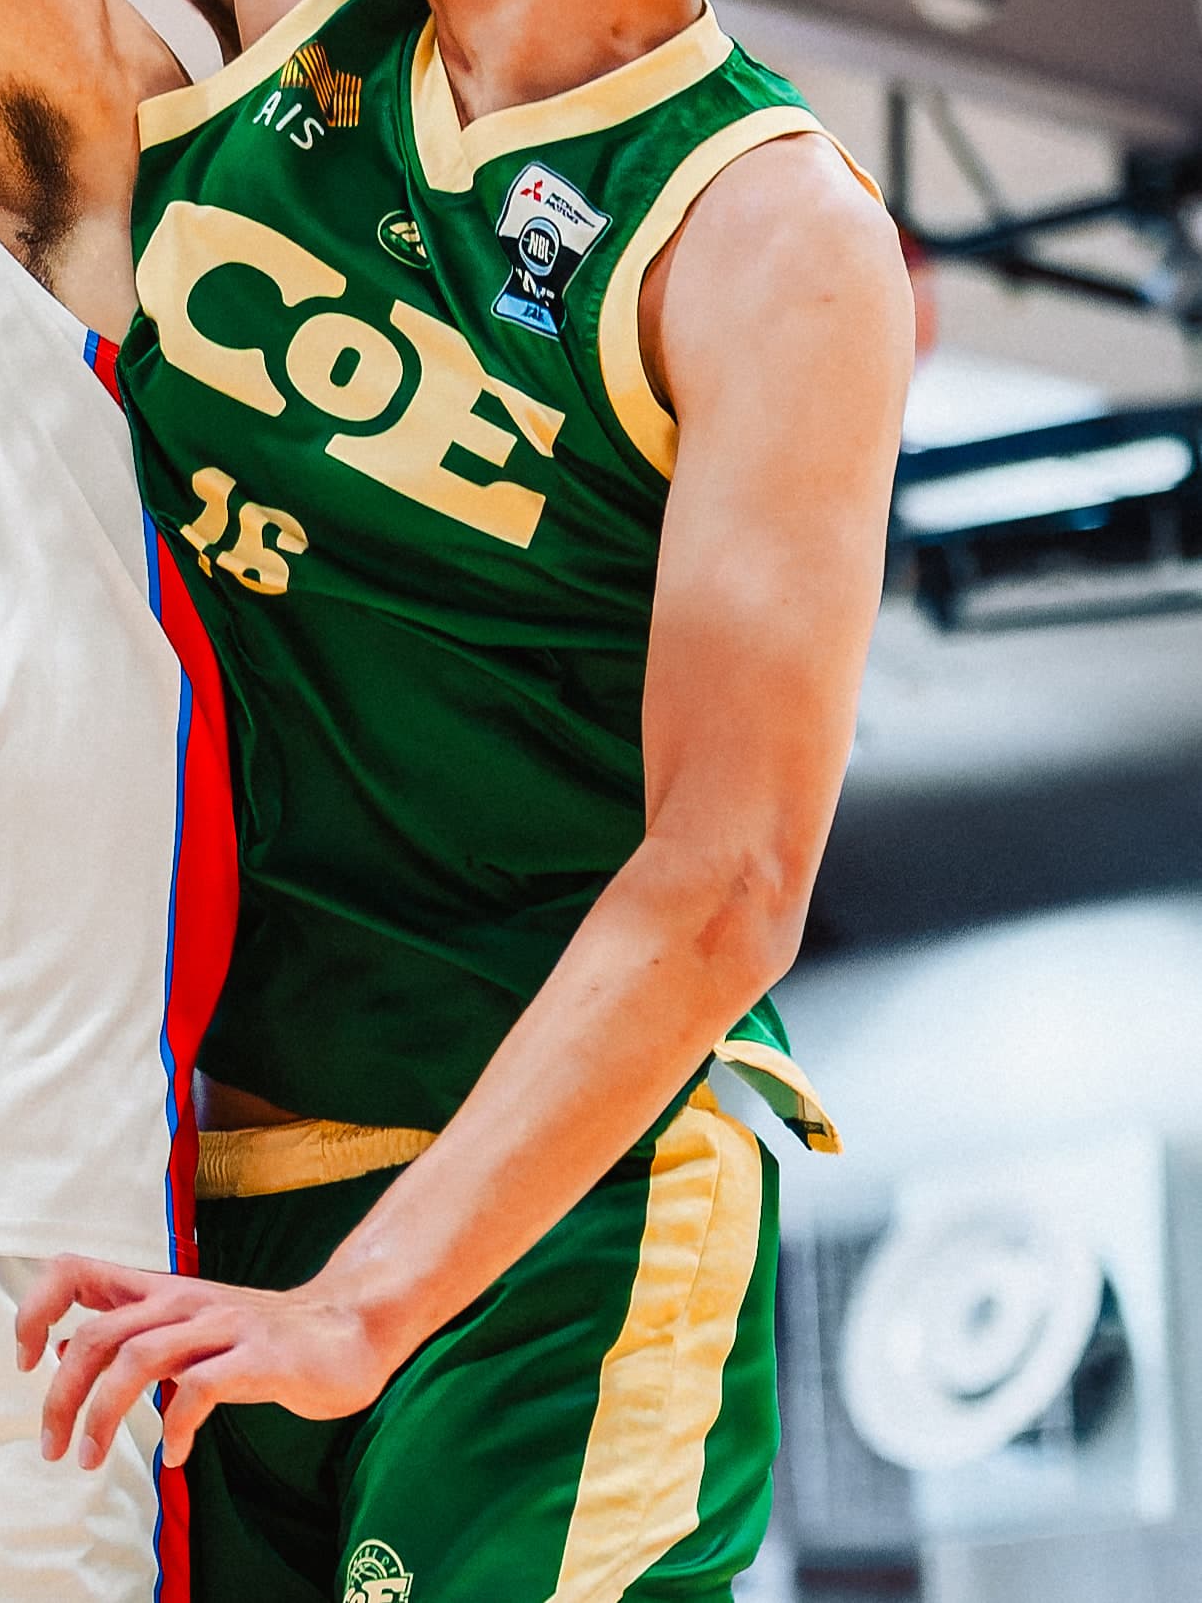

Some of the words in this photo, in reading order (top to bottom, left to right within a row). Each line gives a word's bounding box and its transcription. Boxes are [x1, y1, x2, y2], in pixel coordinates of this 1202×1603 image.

[252, 90, 325, 150] AIS
[527, 230, 550, 264] NBL
[180, 466, 310, 596] 16
